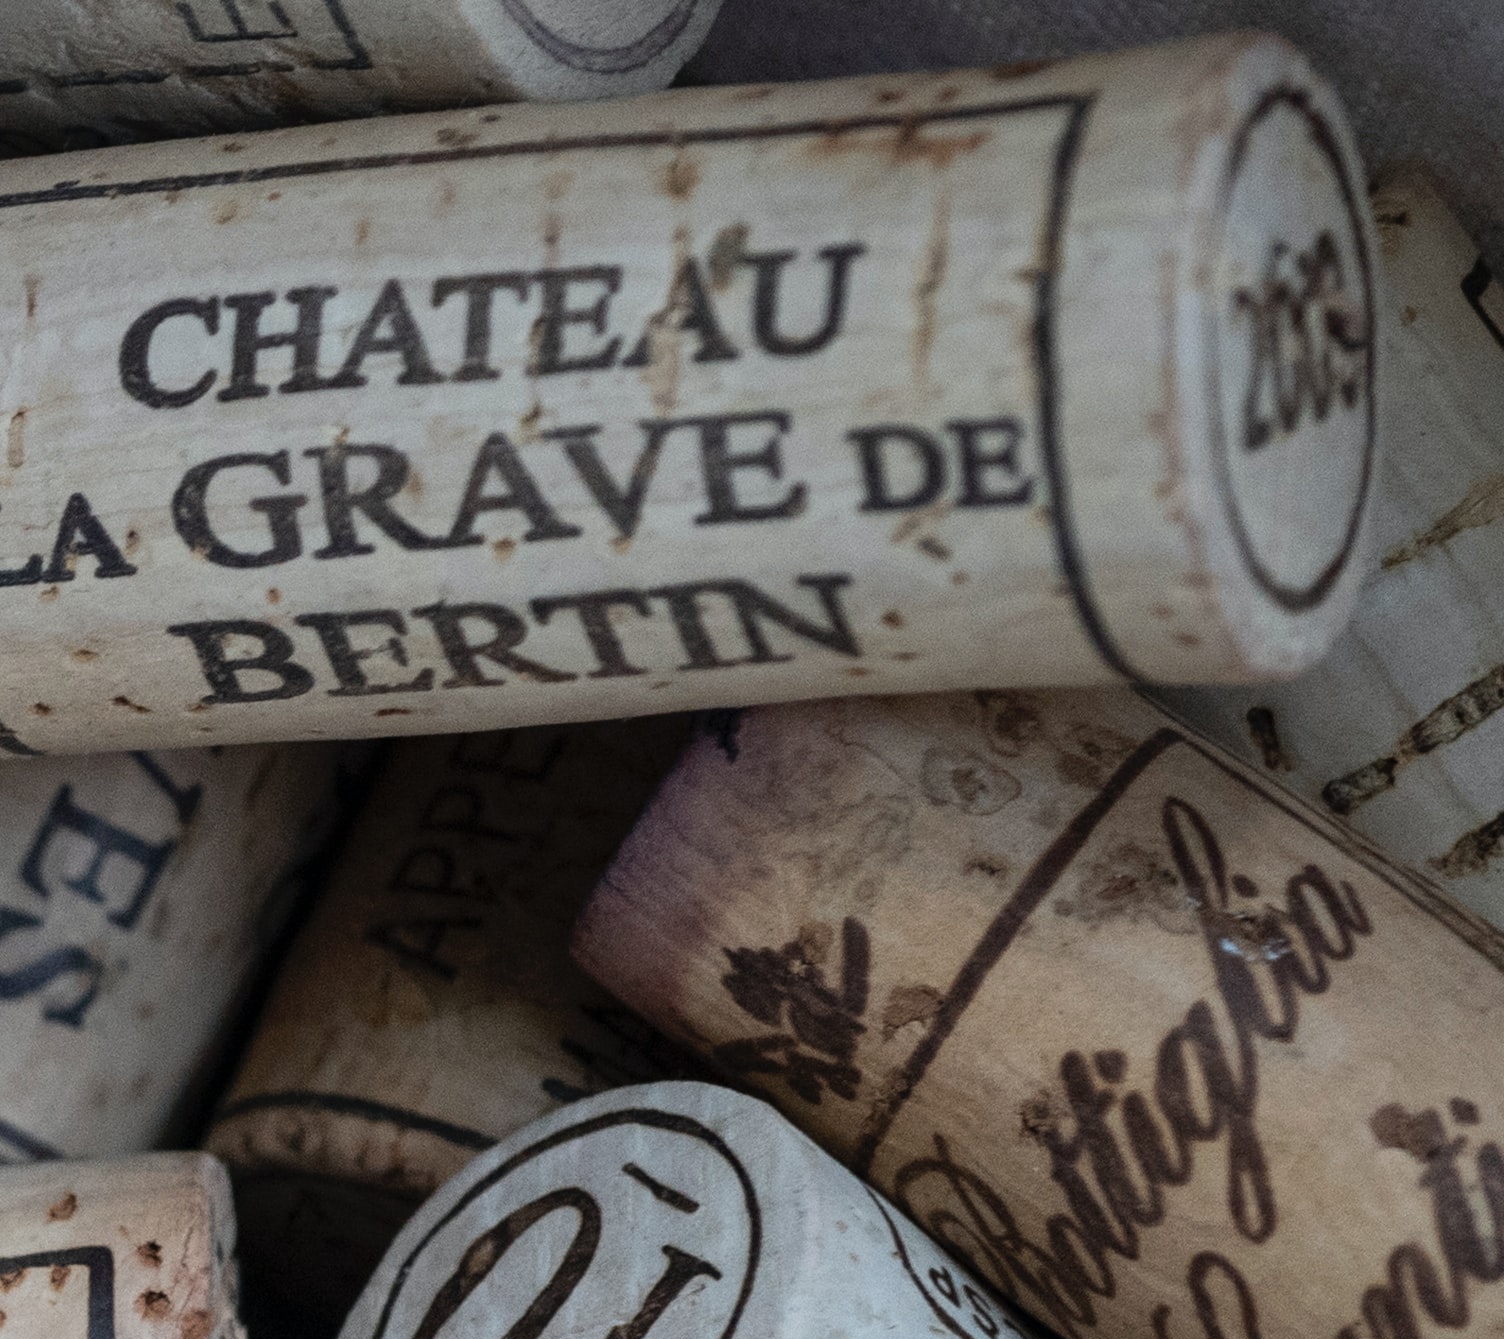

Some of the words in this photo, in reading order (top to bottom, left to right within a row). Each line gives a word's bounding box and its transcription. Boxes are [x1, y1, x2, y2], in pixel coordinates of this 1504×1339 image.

[116, 243, 866, 411] CHATEAU
[169, 408, 808, 571] GRAVE
[846, 416, 1036, 517] DE
[168, 572, 865, 708] BERTIN
[890, 796, 1378, 1330] Bottiglia
